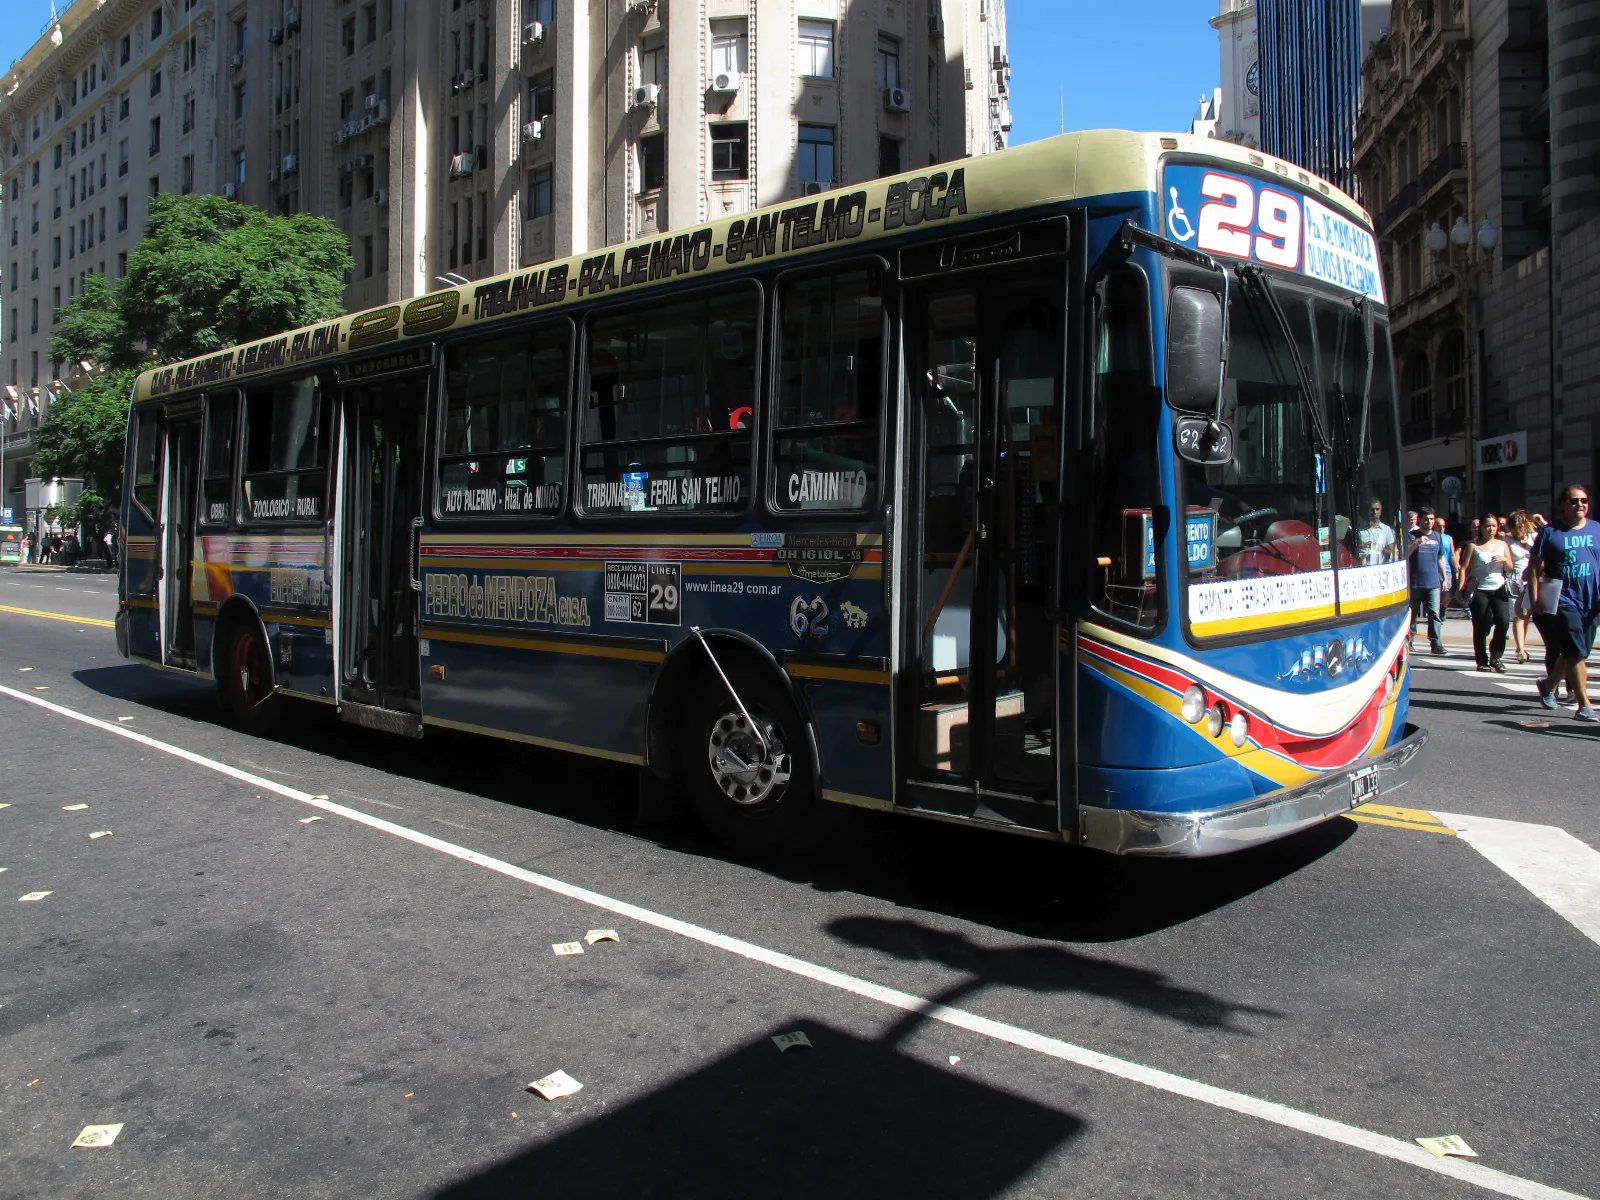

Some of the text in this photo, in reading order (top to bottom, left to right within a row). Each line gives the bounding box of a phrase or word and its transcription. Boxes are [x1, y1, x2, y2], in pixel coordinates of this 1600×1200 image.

[884, 167, 968, 232] BOCA
[726, 190, 868, 264] SAN TELMO
[1196, 171, 1301, 271] 29
[648, 227, 713, 280] MAYO
[474, 263, 569, 321] TRIBUNALES
[349, 290, 461, 350] 29
[1180, 429, 1199, 449] 62
[650, 479, 678, 506] FERIA
[681, 477, 701, 504] SAN
[705, 475, 740, 504] TELMO
[788, 470, 867, 503] CAMINITO
[253, 497, 319, 517] ZOOLOGICO RURAL
[445, 490, 462, 512] ALTO
[464, 487, 497, 511] PALERMO
[523, 487, 533, 510] de
[788, 535, 854, 548] Mercedes-Benz
[1564, 535, 1593, 549] LOVE
[778, 549, 797, 560] OH
[801, 549, 844, 560] 1618L
[607, 564, 637, 572] RECLAMOS
[651, 566, 677, 575] LINEA
[804, 569, 841, 581] metalpar
[1562, 563, 1591, 577] REAL
[426, 573, 468, 617] PEDRO
[469, 574, 483, 619] de
[484, 575, 558, 624] MENDOZA
[607, 595, 628, 603] CNRT
[650, 583, 678, 611] 29
[632, 600, 642, 617] 62
